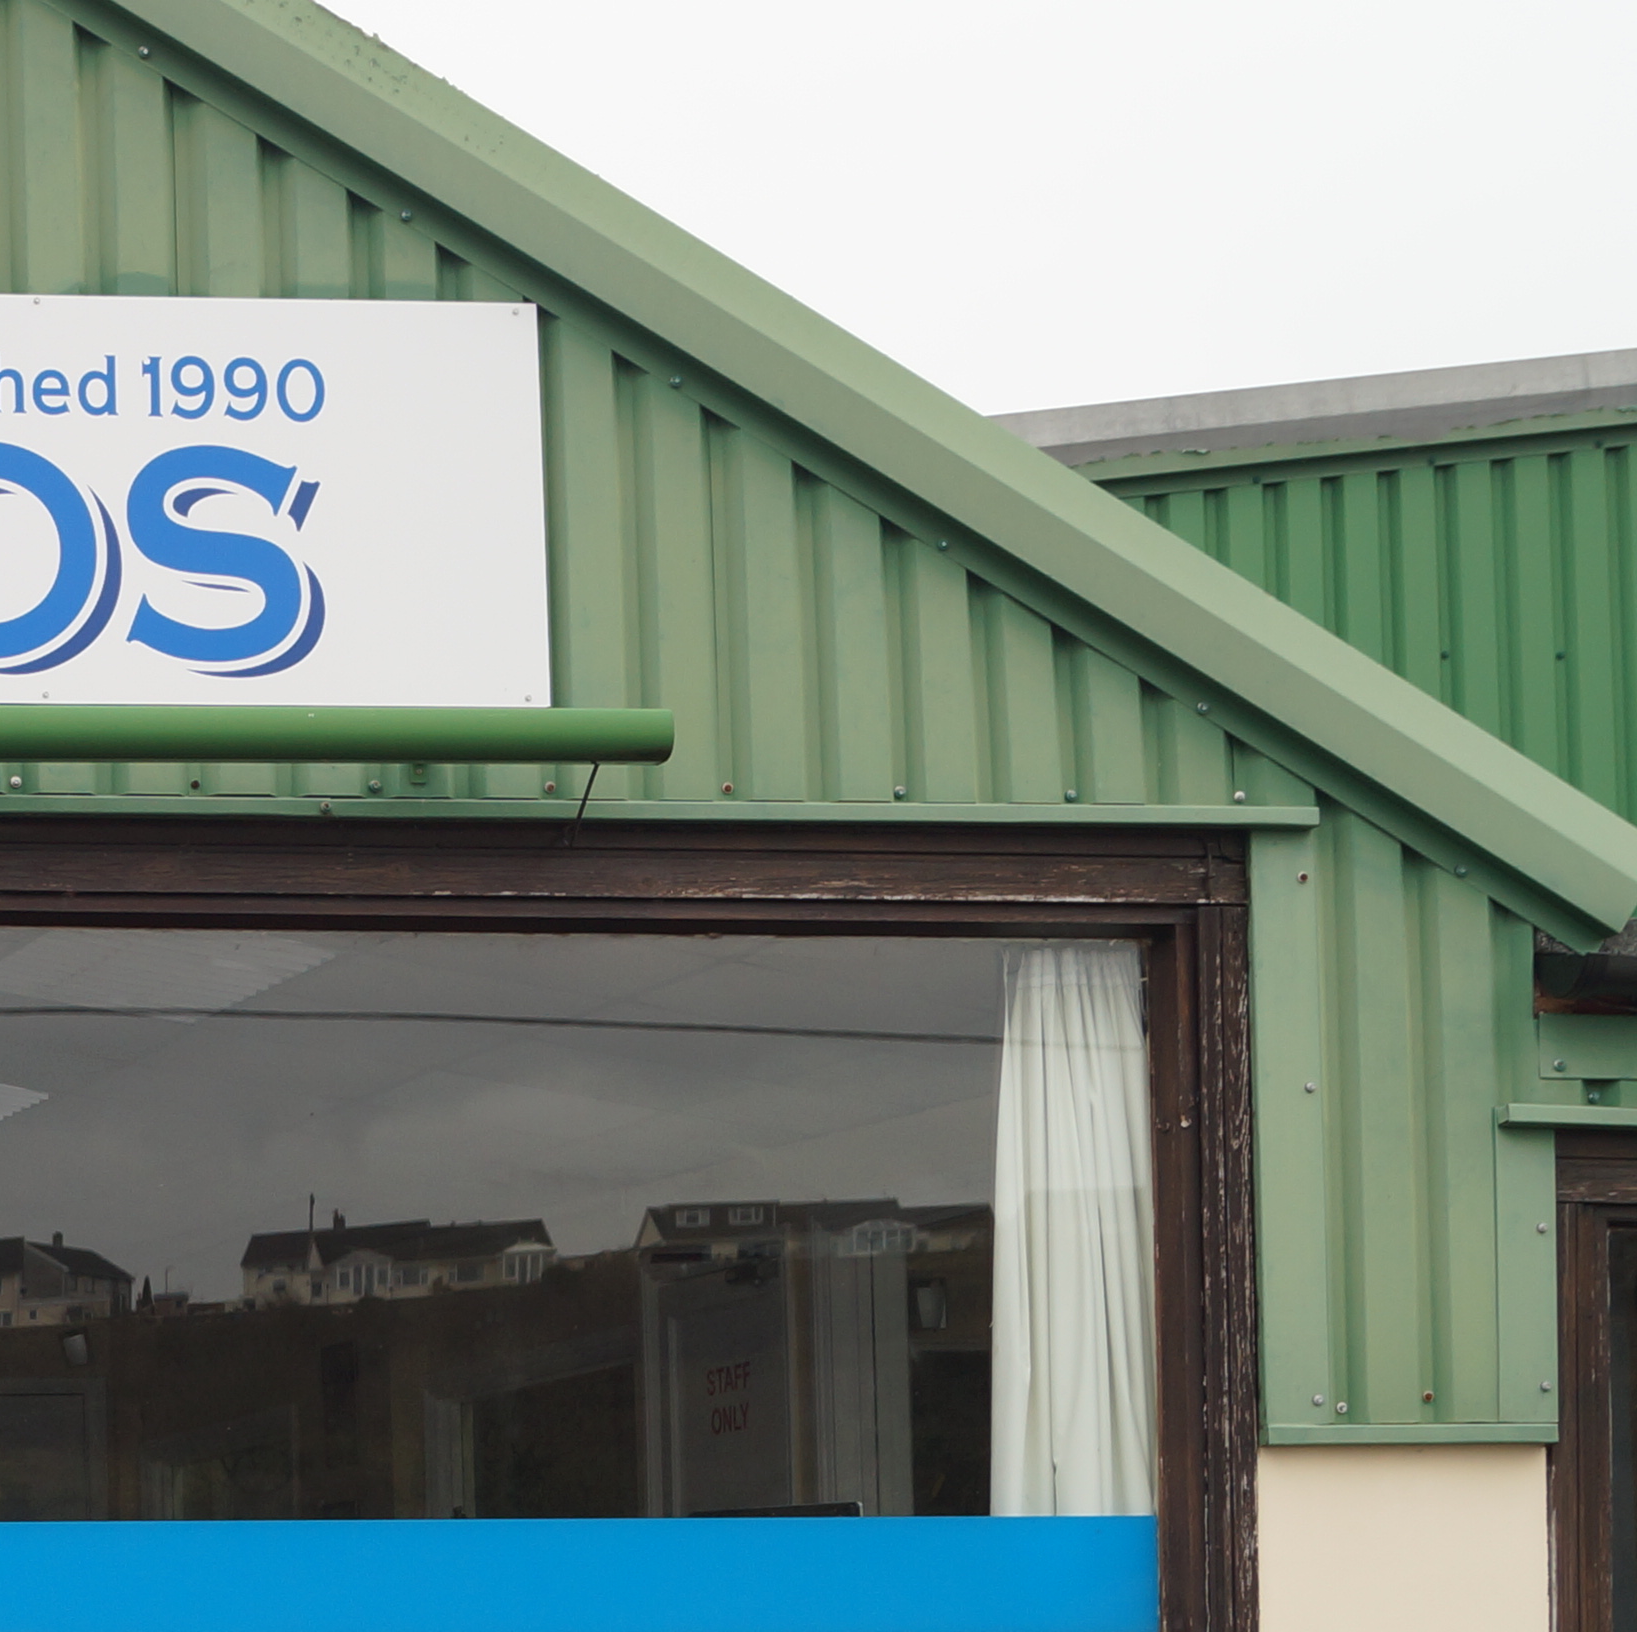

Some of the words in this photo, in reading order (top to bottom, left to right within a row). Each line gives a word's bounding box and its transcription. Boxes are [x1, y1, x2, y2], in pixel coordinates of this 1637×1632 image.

[142, 354, 326, 423] 1990
[706, 1361, 751, 1396] STAFF
[711, 1402, 750, 1435] ONLY
